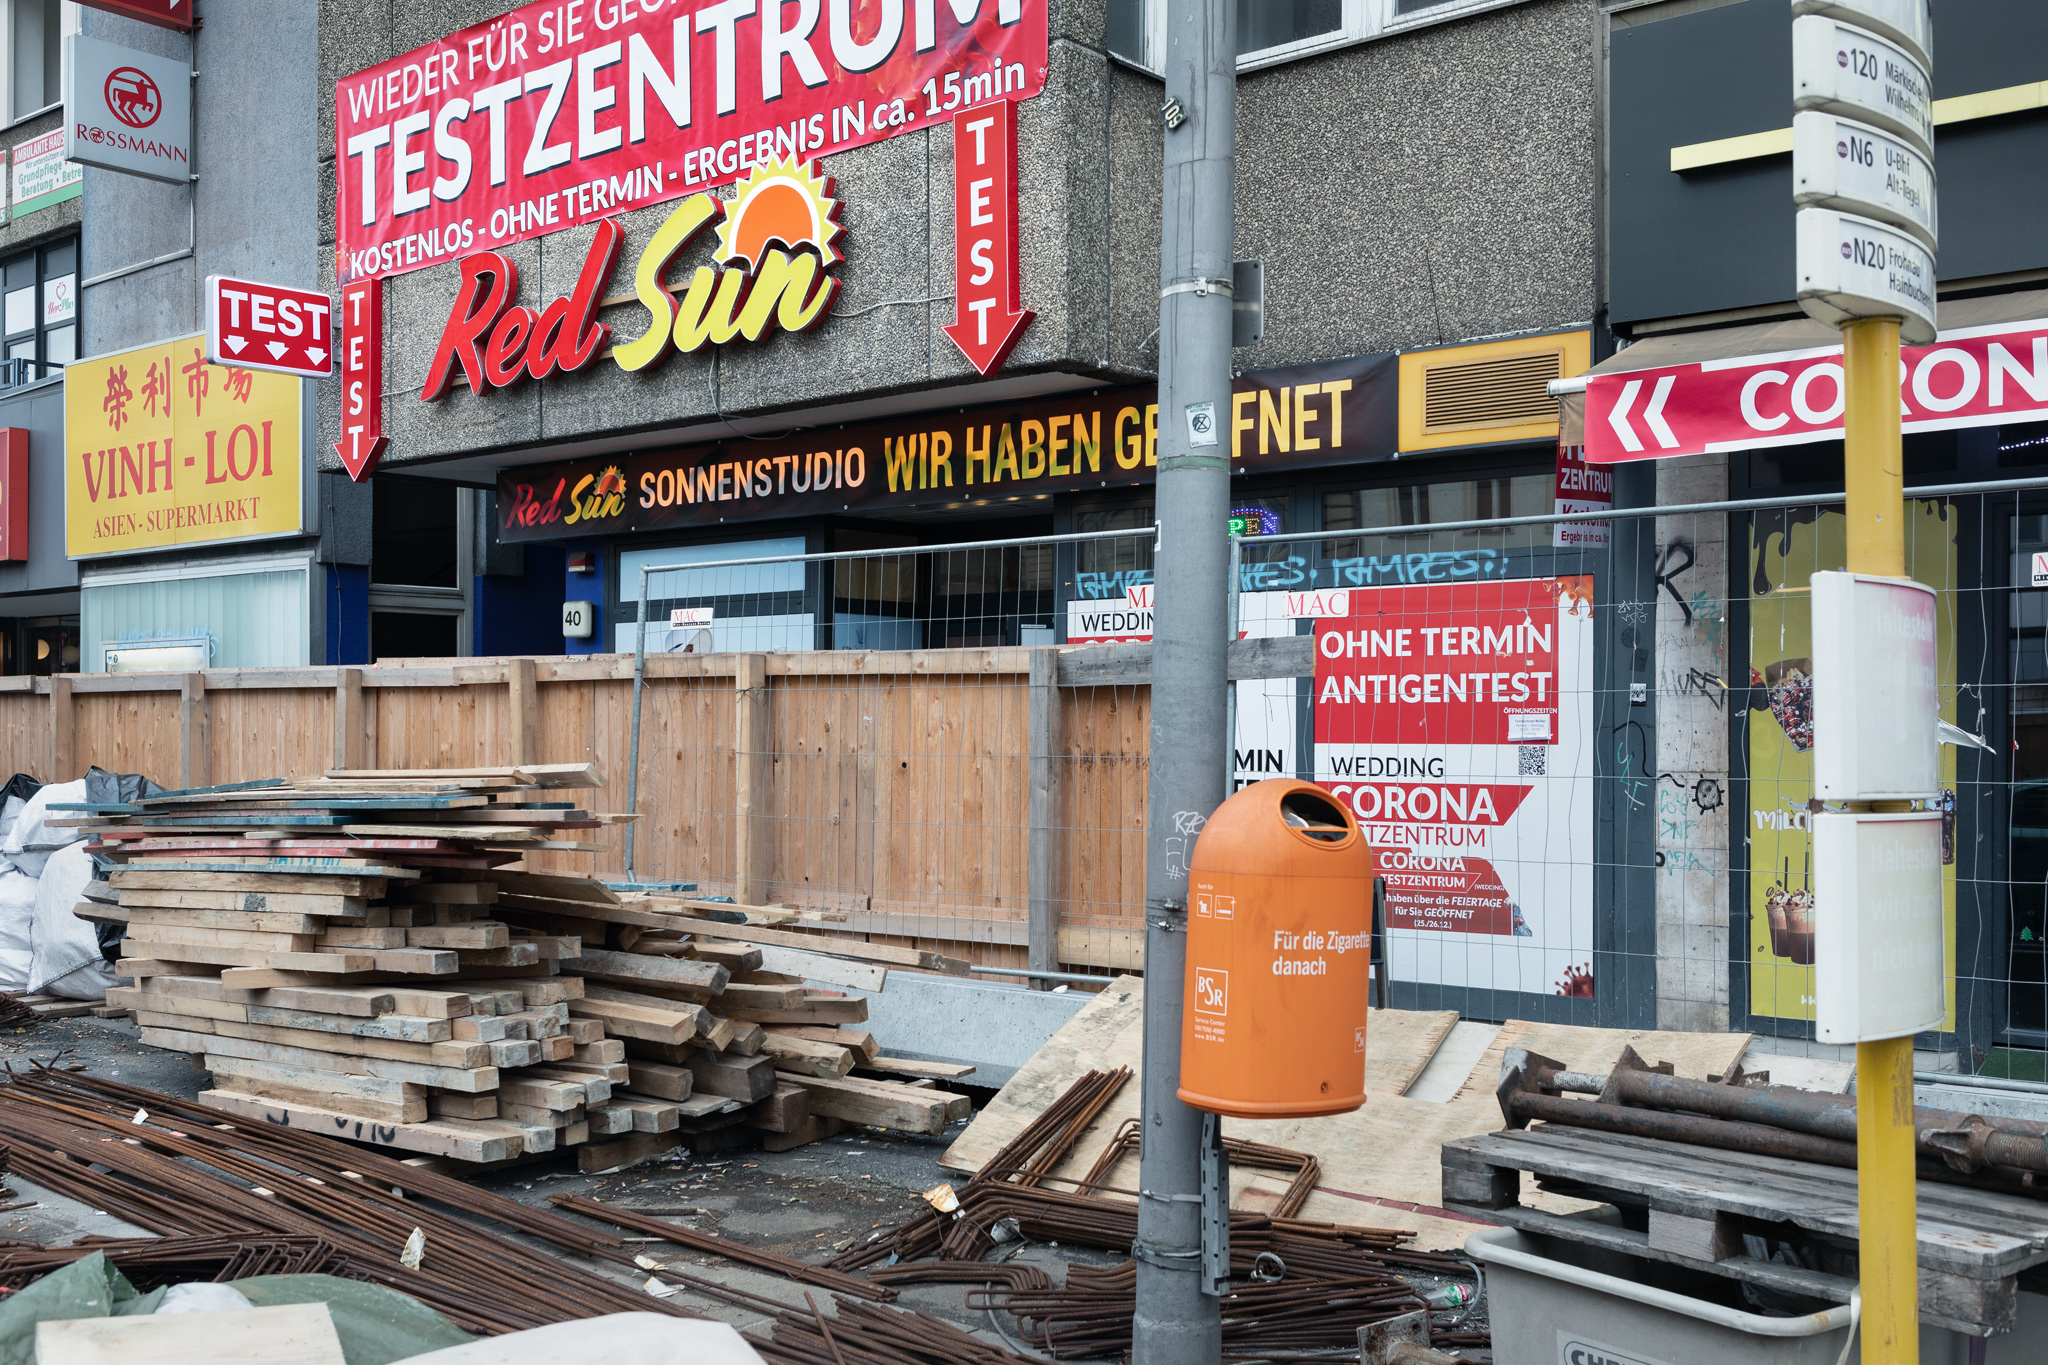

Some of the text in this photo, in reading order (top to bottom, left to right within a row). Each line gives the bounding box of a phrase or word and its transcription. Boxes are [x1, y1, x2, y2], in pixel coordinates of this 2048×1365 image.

[347, 48, 460, 124] WIEDER
[467, 20, 529, 80] FÜR
[537, 1, 584, 54] SIE
[1851, 48, 1878, 81] 120
[77, 123, 188, 164] ROSSMANN
[1850, 136, 1874, 168] N6
[18, 161, 63, 185] Grundpflege
[350, 217, 475, 280] KOSTENLOS
[490, 191, 560, 241] OHNE
[561, 161, 664, 222] TERMIN
[683, 111, 825, 187] ERGEBNIS
[831, 100, 867, 145] IN
[871, 97, 916, 132] ca.
[921, 57, 1027, 117] 15min
[21, 178, 54, 199] Beratung
[965, 116, 996, 347] TEST
[1853, 238, 1886, 271] N20
[421, 194, 838, 402] Red Sun
[221, 288, 330, 341] TEST
[347, 290, 366, 460] TEST
[1740, 336, 2048, 432] COON
[82, 437, 174, 503] VINH
[205, 420, 274, 485] LOI
[505, 477, 566, 529] Red
[564, 473, 626, 525] Sun
[639, 447, 866, 509] SONNENSTUDIO
[885, 431, 954, 493] WIR
[966, 411, 1101, 485] HABEN
[1229, 516, 1279, 535] PEN
[565, 611, 581, 626] 40
[1287, 592, 1348, 618] MAC
[1320, 623, 1552, 659] OHNE TERMIN
[1319, 671, 1552, 704] ANTIGENTEST
[1503, 706, 1558, 715] ÖFFNUNGSZEITEN
[1234, 749, 1283, 773] MIN
[1331, 756, 1444, 778] WEDDING
[1330, 784, 1500, 824] CORONA
[1358, 824, 1487, 848] TZENTRUM
[1379, 851, 1467, 872] CORONA
[1380, 873, 1466, 889] TESTZENTRUM
[1386, 893, 1502, 909] haben über die FEIERTAGE
[1394, 906, 1475, 920] für Sie GEÖFFNET
[1273, 930, 1370, 955] Für die Zigarette
[1272, 956, 1327, 976] danach
[1198, 976, 1224, 1007] BSR
